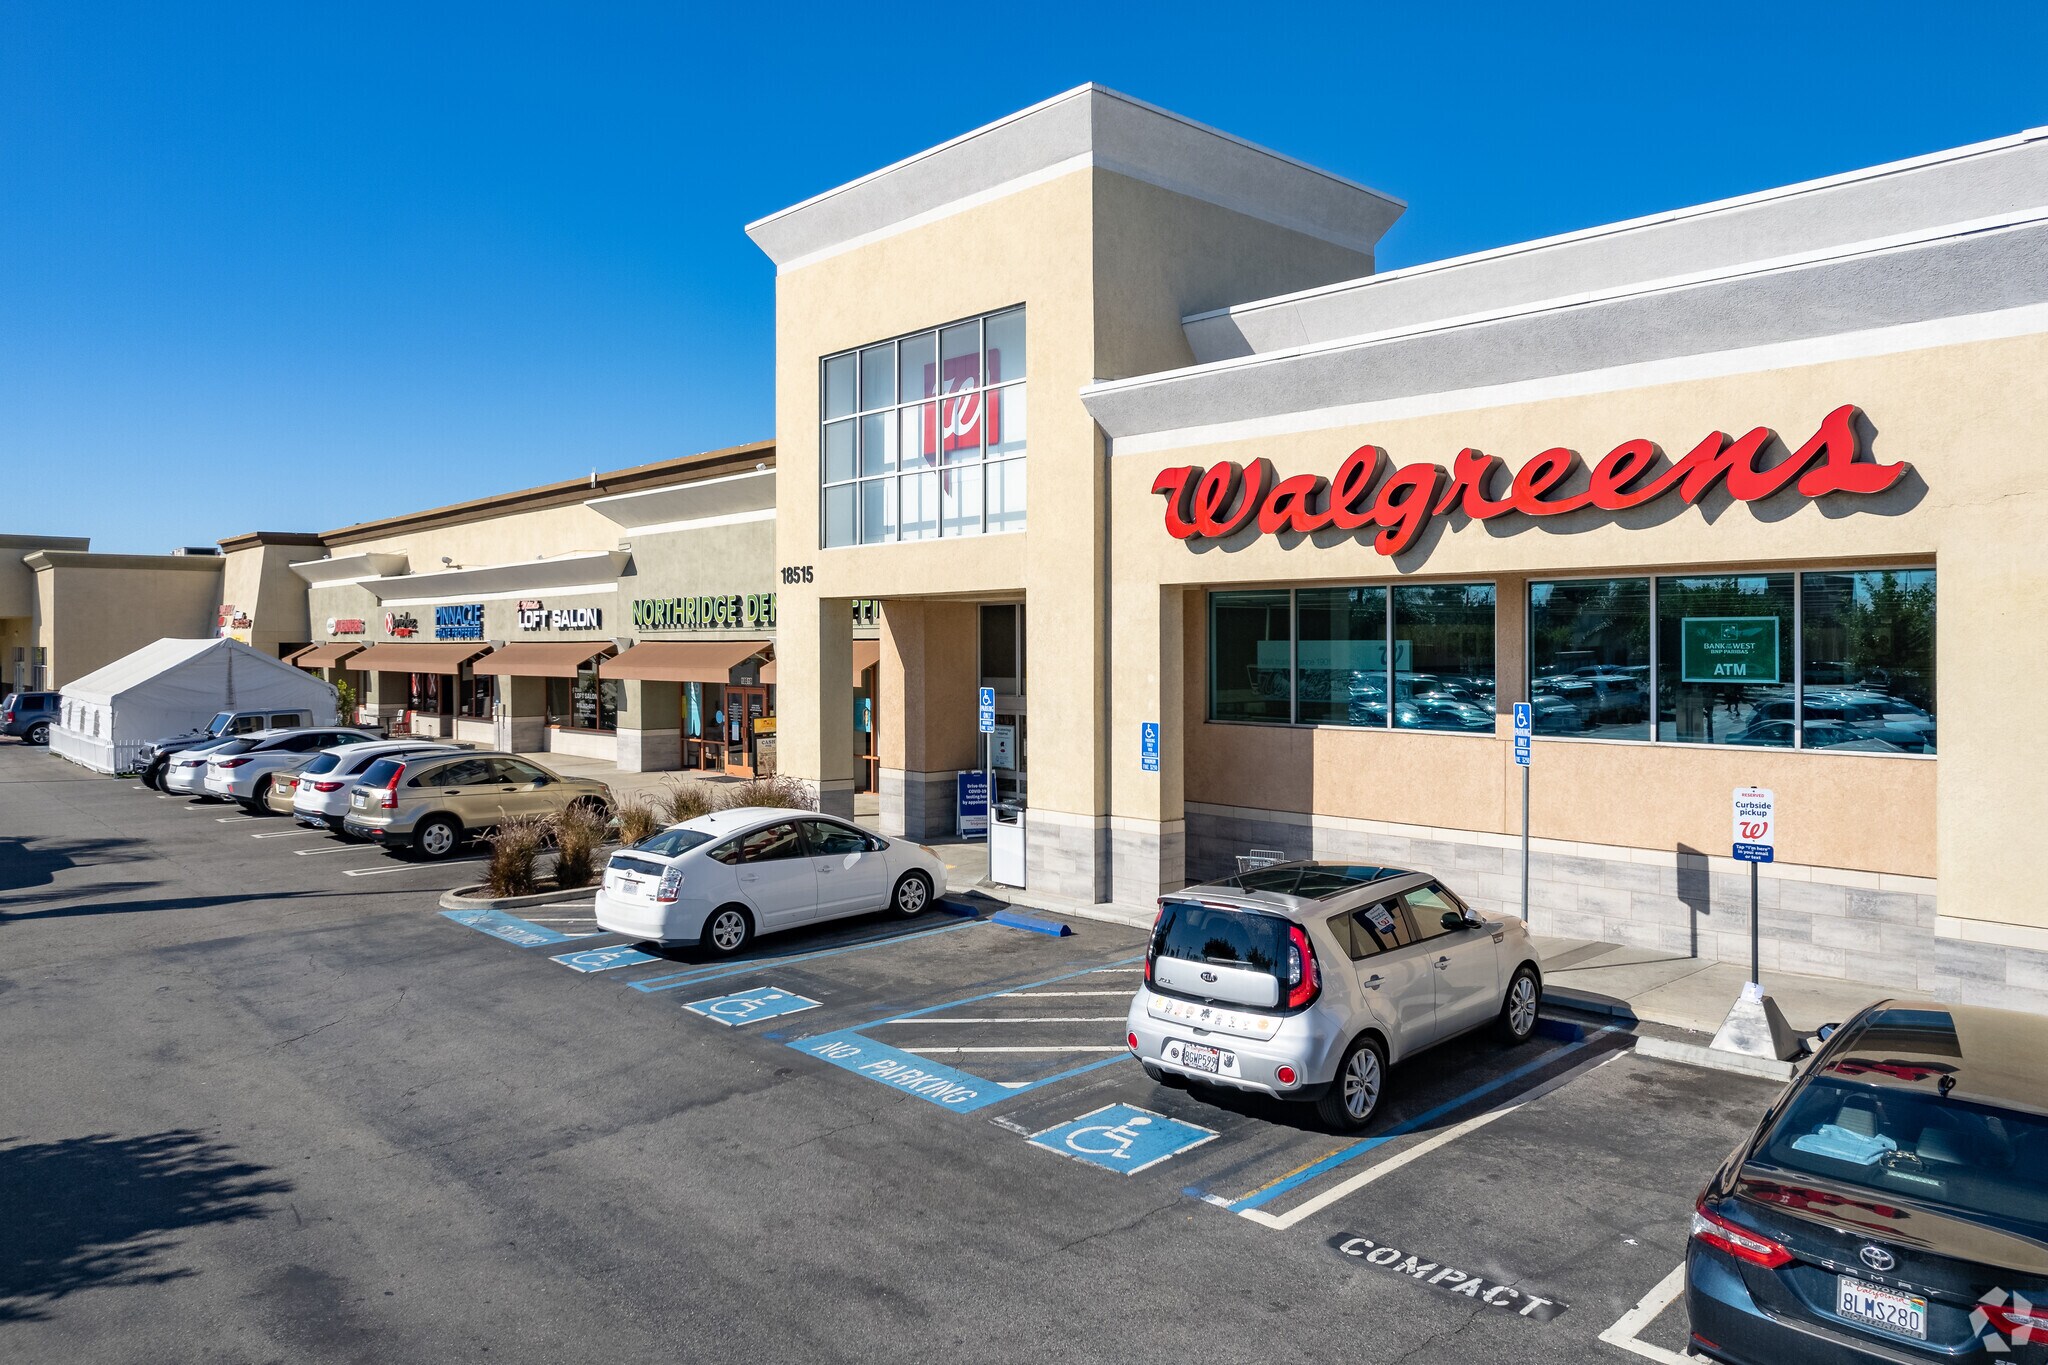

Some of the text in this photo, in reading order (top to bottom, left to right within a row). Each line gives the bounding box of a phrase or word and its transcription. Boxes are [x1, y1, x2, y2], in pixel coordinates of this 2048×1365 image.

[1151, 404, 1908, 556] Walgreens
[780, 565, 814, 584] 18515
[435, 604, 481, 625] PINNACLE
[518, 608, 598, 628] LOFT SALON
[632, 595, 737, 625] NORTHRIDGE
[1713, 663, 1747, 676] ATM
[1518, 738, 1527, 746] ONLY
[1735, 801, 1772, 809] Curbside
[1739, 809, 1767, 817] pickup
[1184, 1050, 1217, 1068] 8GWP599
[811, 1041, 978, 1104] NO PARKING
[1339, 1237, 1553, 1316] COMPACT
[1821, 1259, 1941, 1295] CAMRY
[1856, 1284, 1910, 1306] California
[1843, 1292, 1919, 1331] 8LMS280
